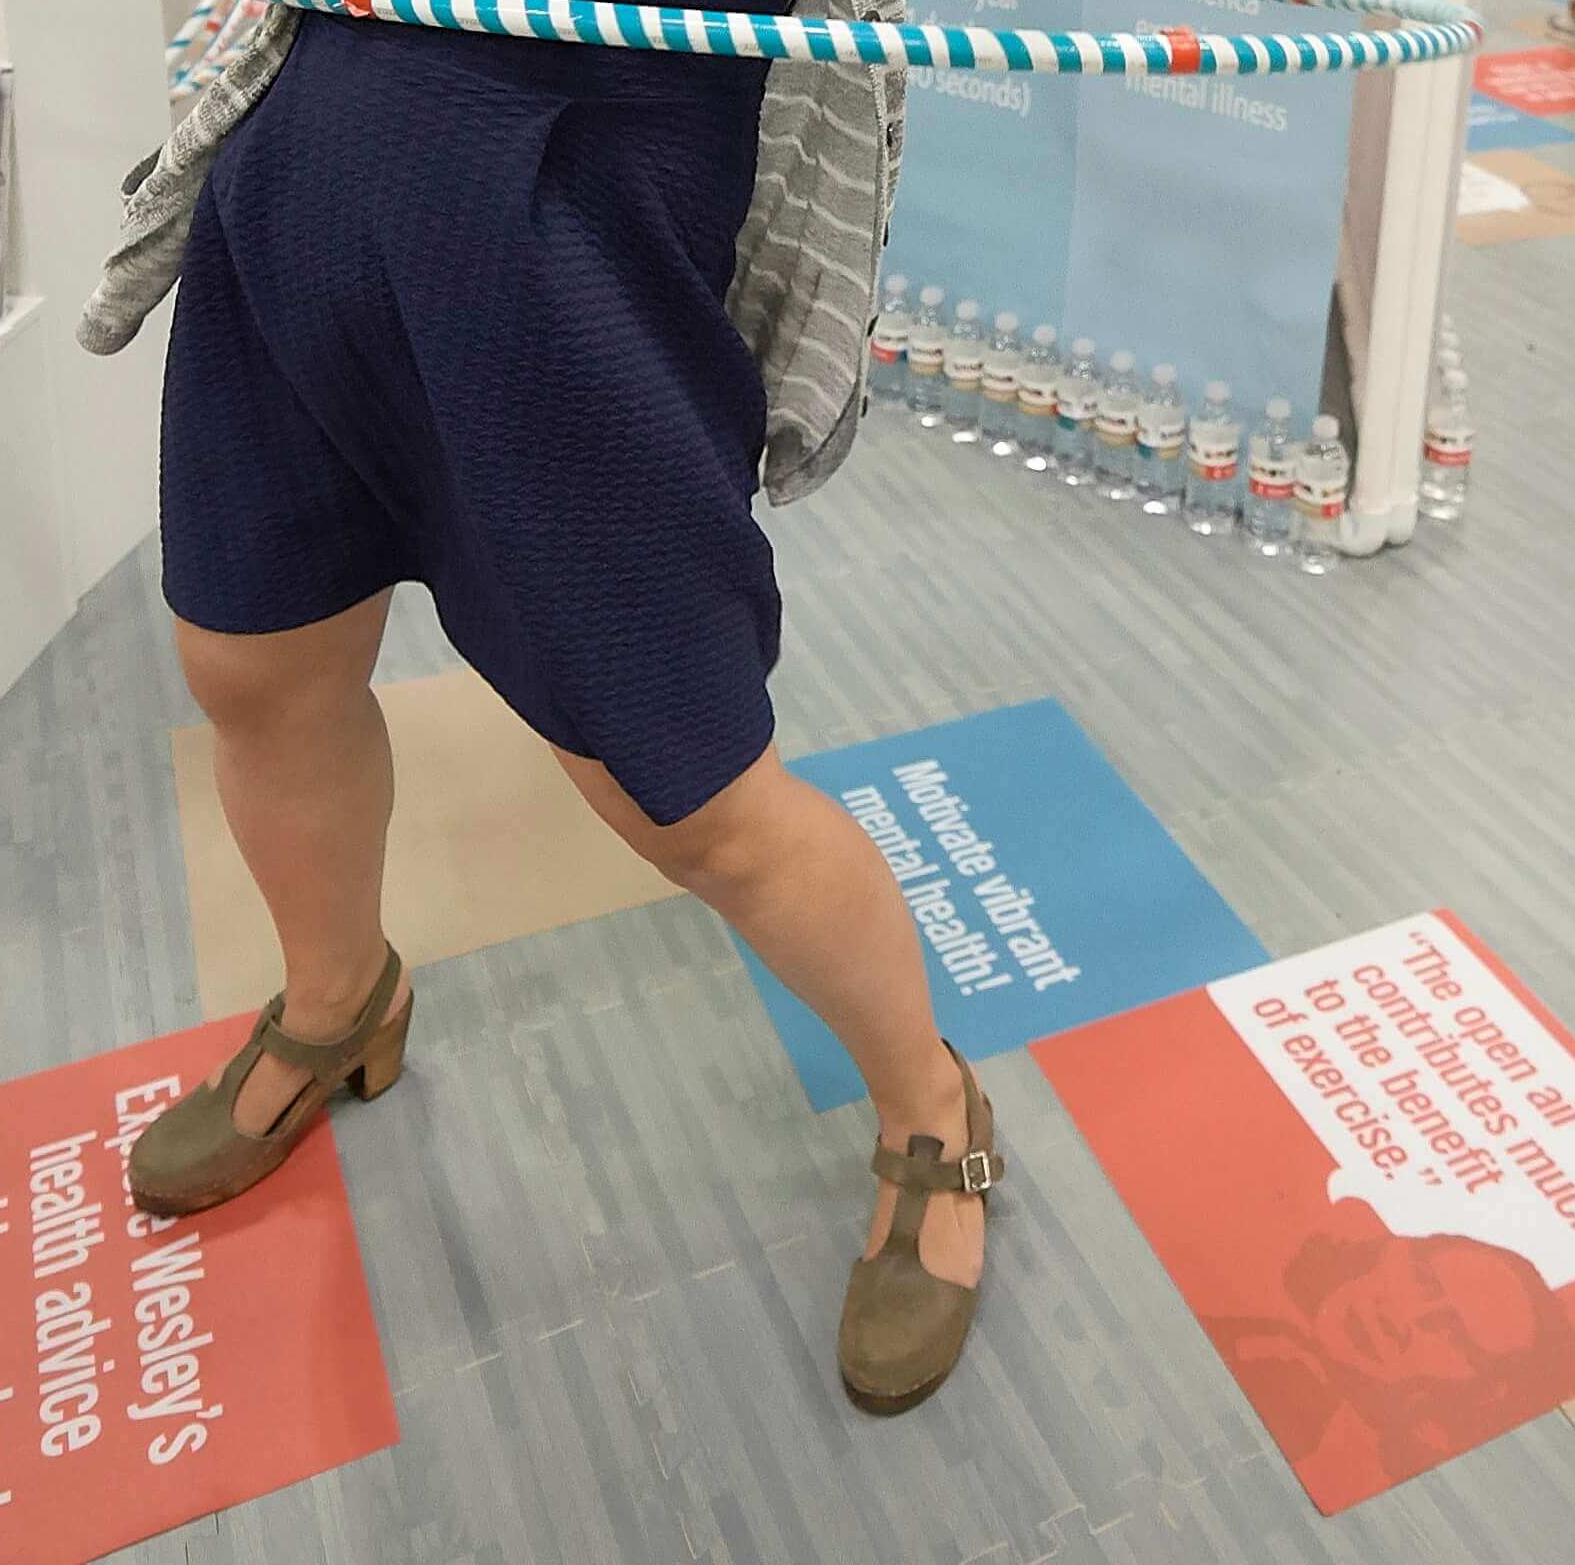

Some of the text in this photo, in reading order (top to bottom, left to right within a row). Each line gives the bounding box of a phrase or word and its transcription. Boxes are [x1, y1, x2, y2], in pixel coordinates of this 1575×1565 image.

[936, 71, 1032, 116] seconds)
[1211, 80, 1288, 132] illness
[841, 785, 1013, 997] mental health!
[892, 758, 1081, 992] Motivate vibrant
[1251, 996, 1308, 1030] of
[1303, 978, 1506, 1196] to the benefit
[1351, 963, 1520, 1138] contributes
[1453, 1005, 1538, 1083] open
[30, 1130, 115, 1458] health advice
[127, 1232, 224, 1465] Wesley's
